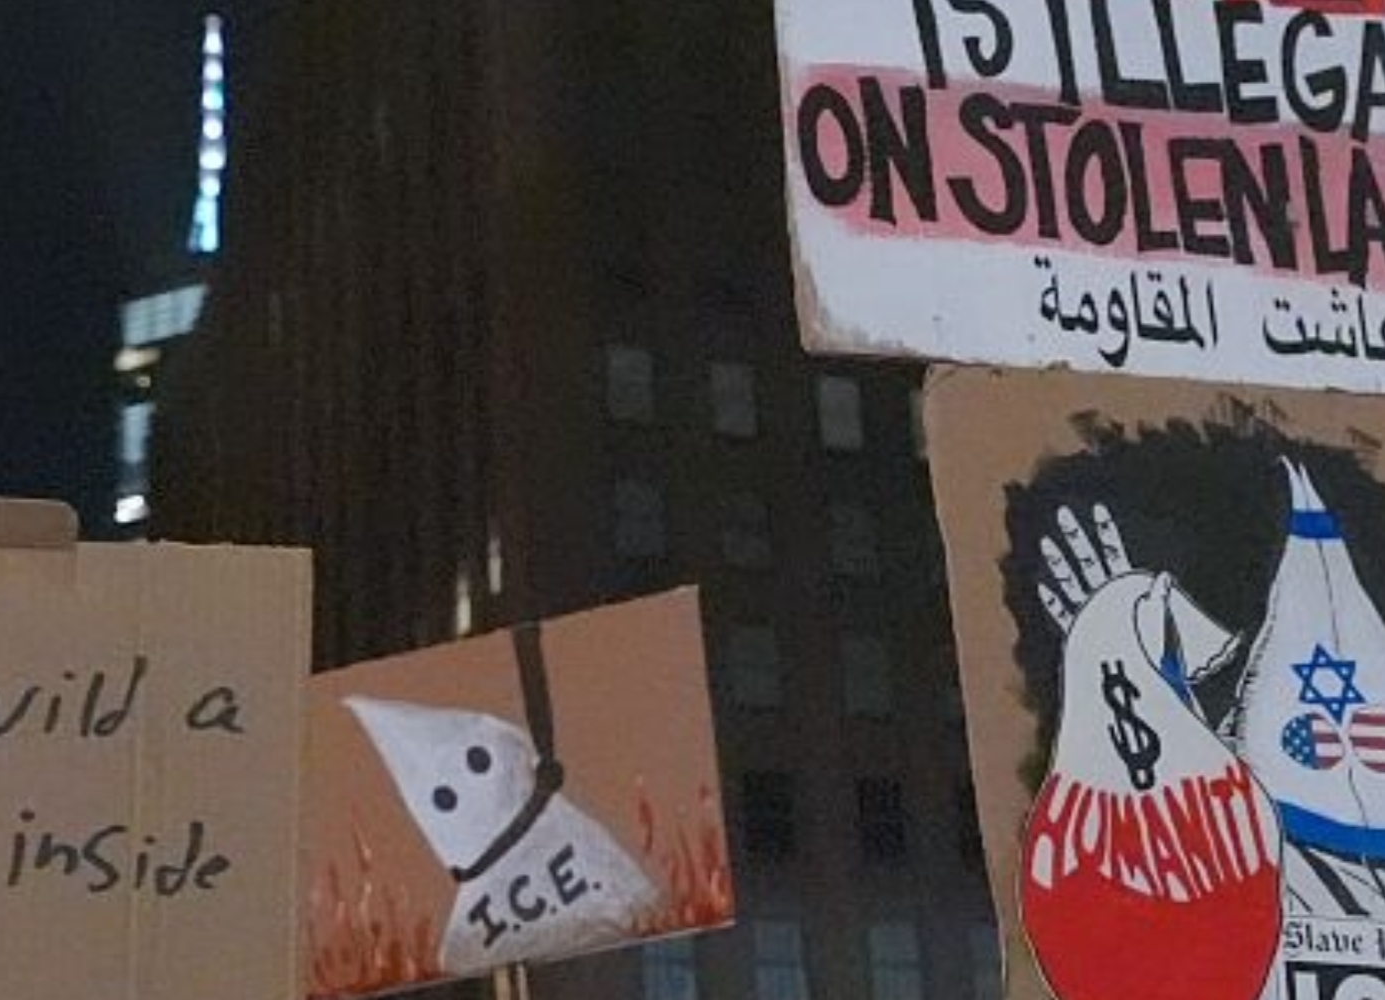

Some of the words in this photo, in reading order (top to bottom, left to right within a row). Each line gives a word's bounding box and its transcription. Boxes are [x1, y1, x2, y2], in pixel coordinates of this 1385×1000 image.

[914, 0, 1013, 89] IS
[797, 76, 939, 227] ON
[946, 93, 1298, 272] STOLEN
[1034, 256, 1219, 367] المقاومة
[185, 686, 245, 734] a
[6, 809, 232, 896] inside
[1025, 756, 1270, 901] HUMANITY
[466, 843, 602, 949] I.C.E.
[1283, 920, 1364, 959] Slave
